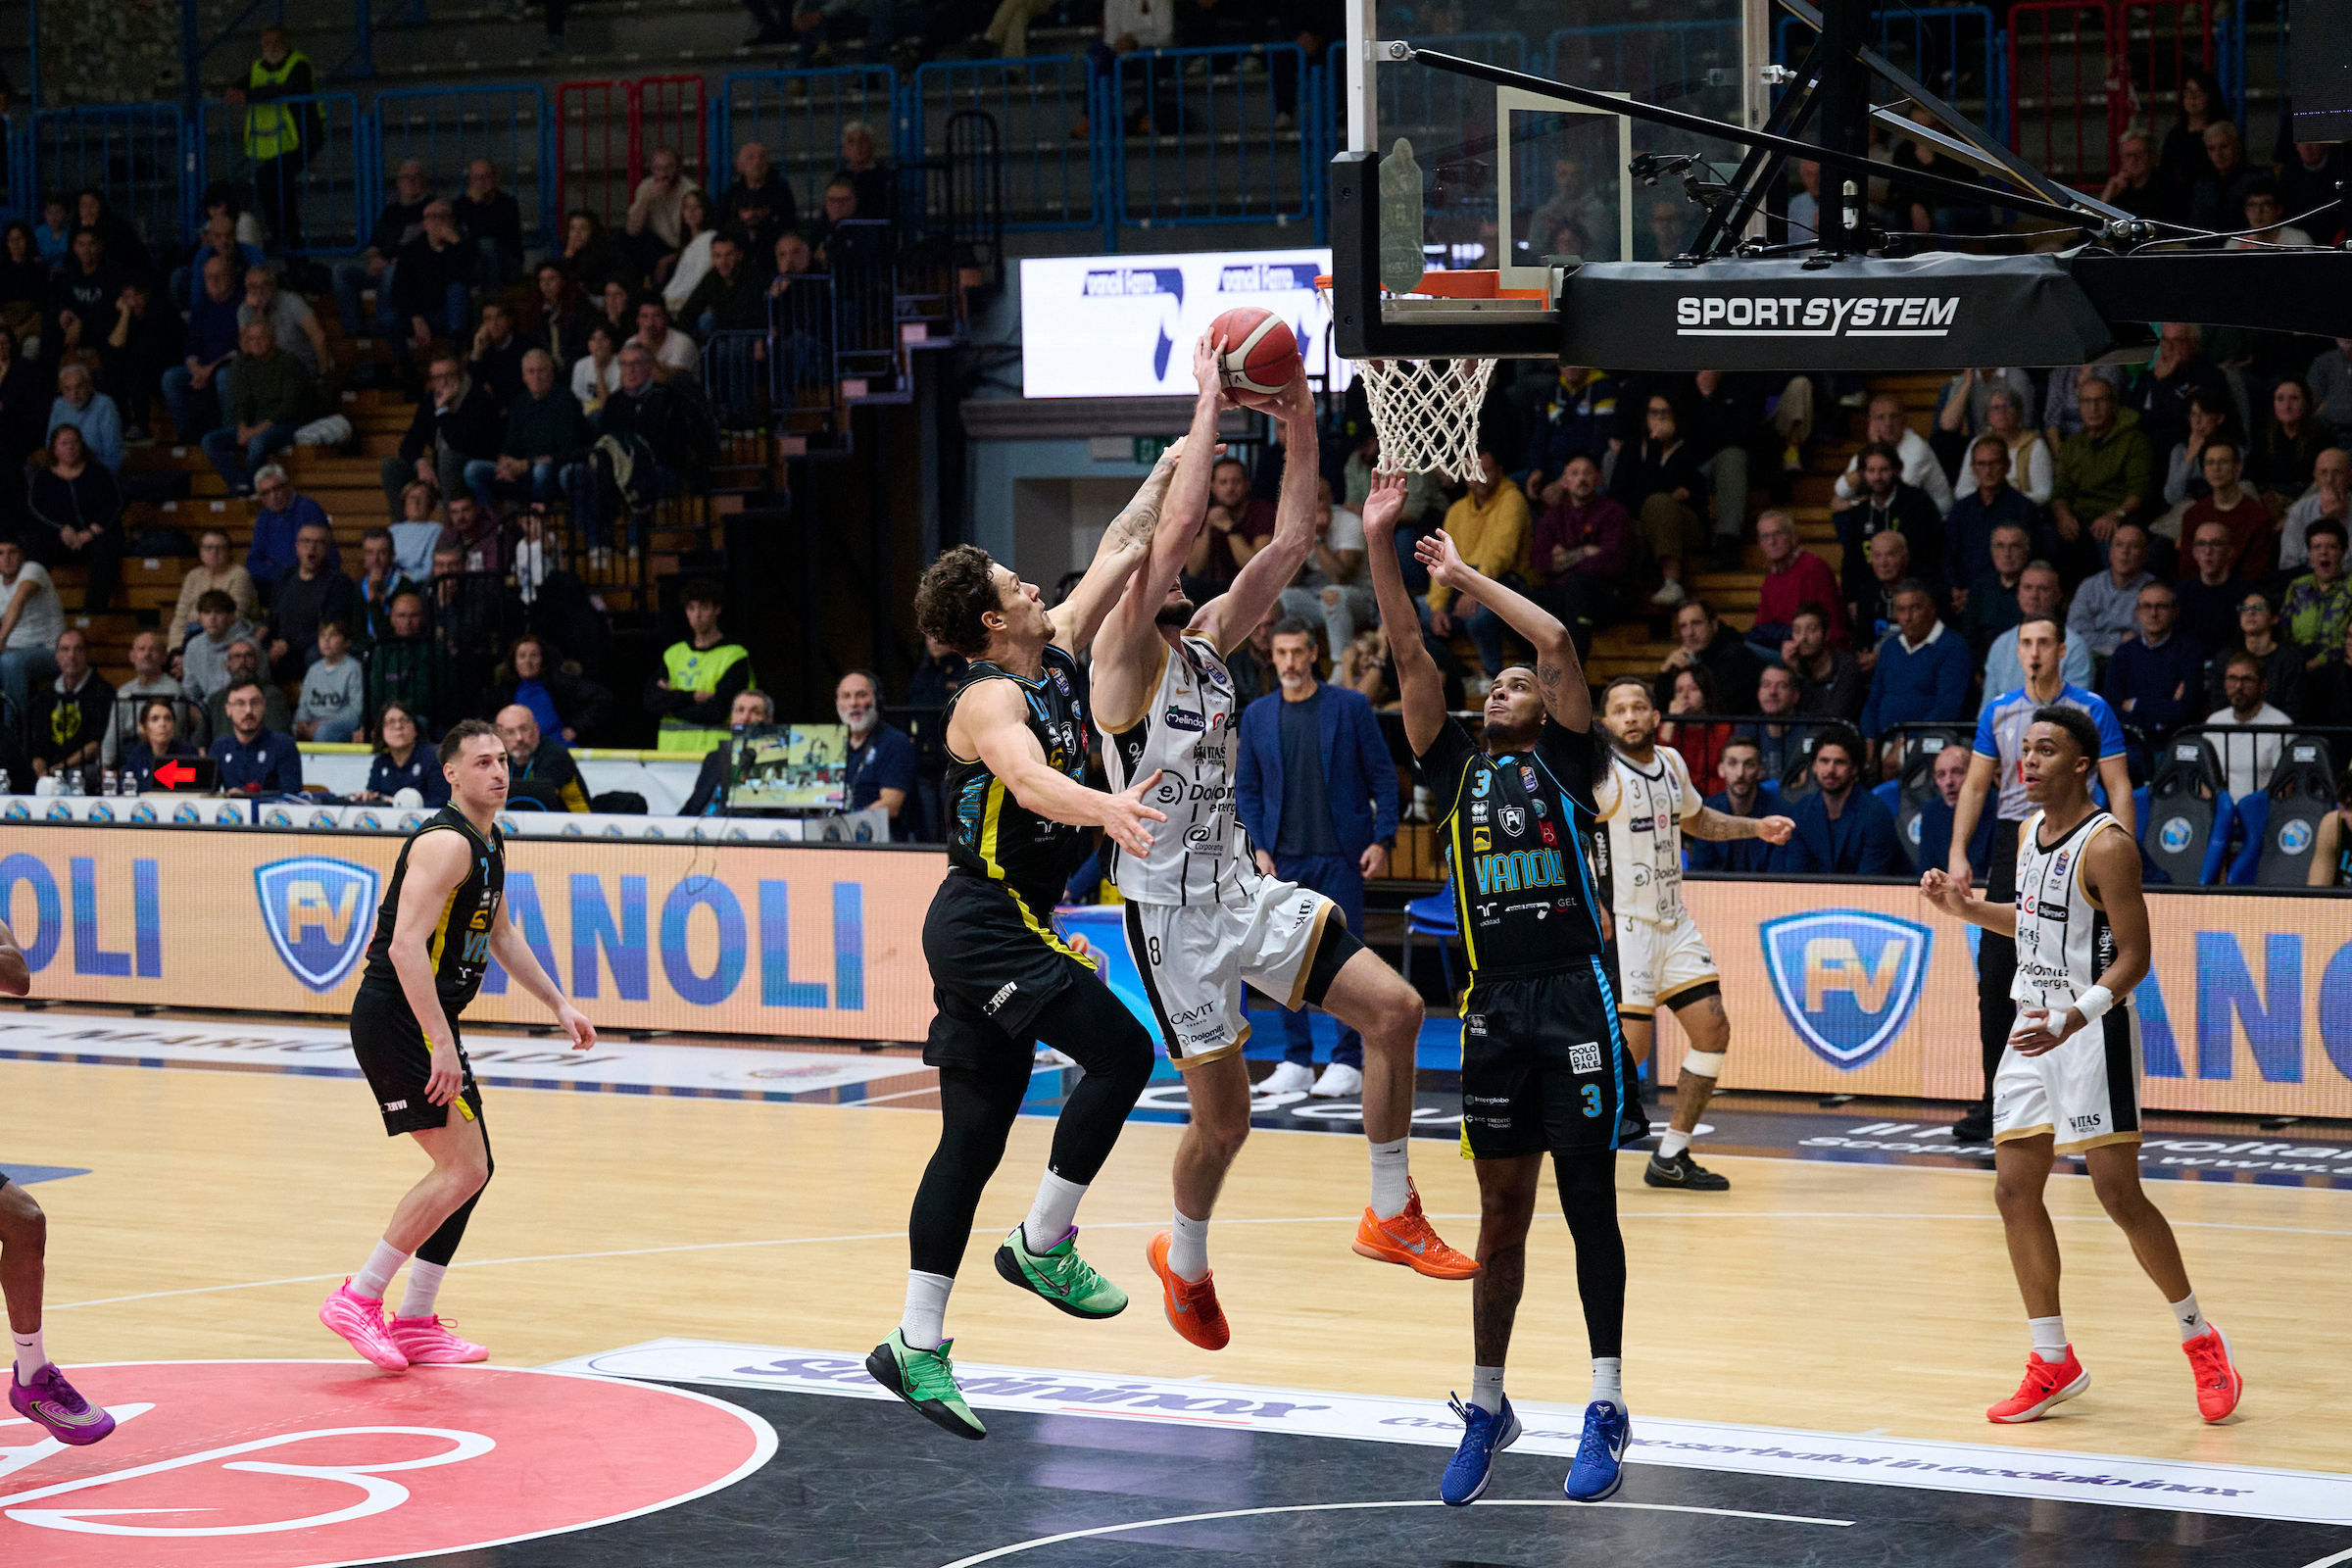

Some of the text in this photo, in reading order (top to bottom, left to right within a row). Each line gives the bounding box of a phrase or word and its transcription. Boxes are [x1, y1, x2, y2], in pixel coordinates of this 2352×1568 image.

[1677, 296, 1960, 336] SPORTSYSTEM
[1166, 713, 1205, 730] Melinda
[1471, 769, 1493, 799] 3
[1631, 779, 1642, 800] 3
[1195, 842, 1224, 852] Corporate
[480, 857, 490, 886] 7
[480, 870, 864, 1011] ANOLI
[1149, 936, 1162, 966] 8
[991, 981, 1018, 1008] FERVI
[1170, 1001, 1214, 1025] CAVIT
[1191, 1024, 1224, 1044] Dolomiti
[1203, 1032, 1225, 1045] energia
[466, 1050, 624, 1067] ADI
[1572, 1045, 1596, 1056] POLO
[1573, 1054, 1597, 1064] DIGI
[1575, 1060, 1599, 1072] TALE
[1474, 1096, 1510, 1105] Interglobo
[1581, 1084, 1603, 1118] 3
[2077, 1113, 2101, 1128] ITAS
[1666, 1441, 1893, 1466] serbatoi
[1886, 1459, 1940, 1471] in
[1939, 1465, 2132, 1487] acciaio
[2129, 1479, 2256, 1497] inox
